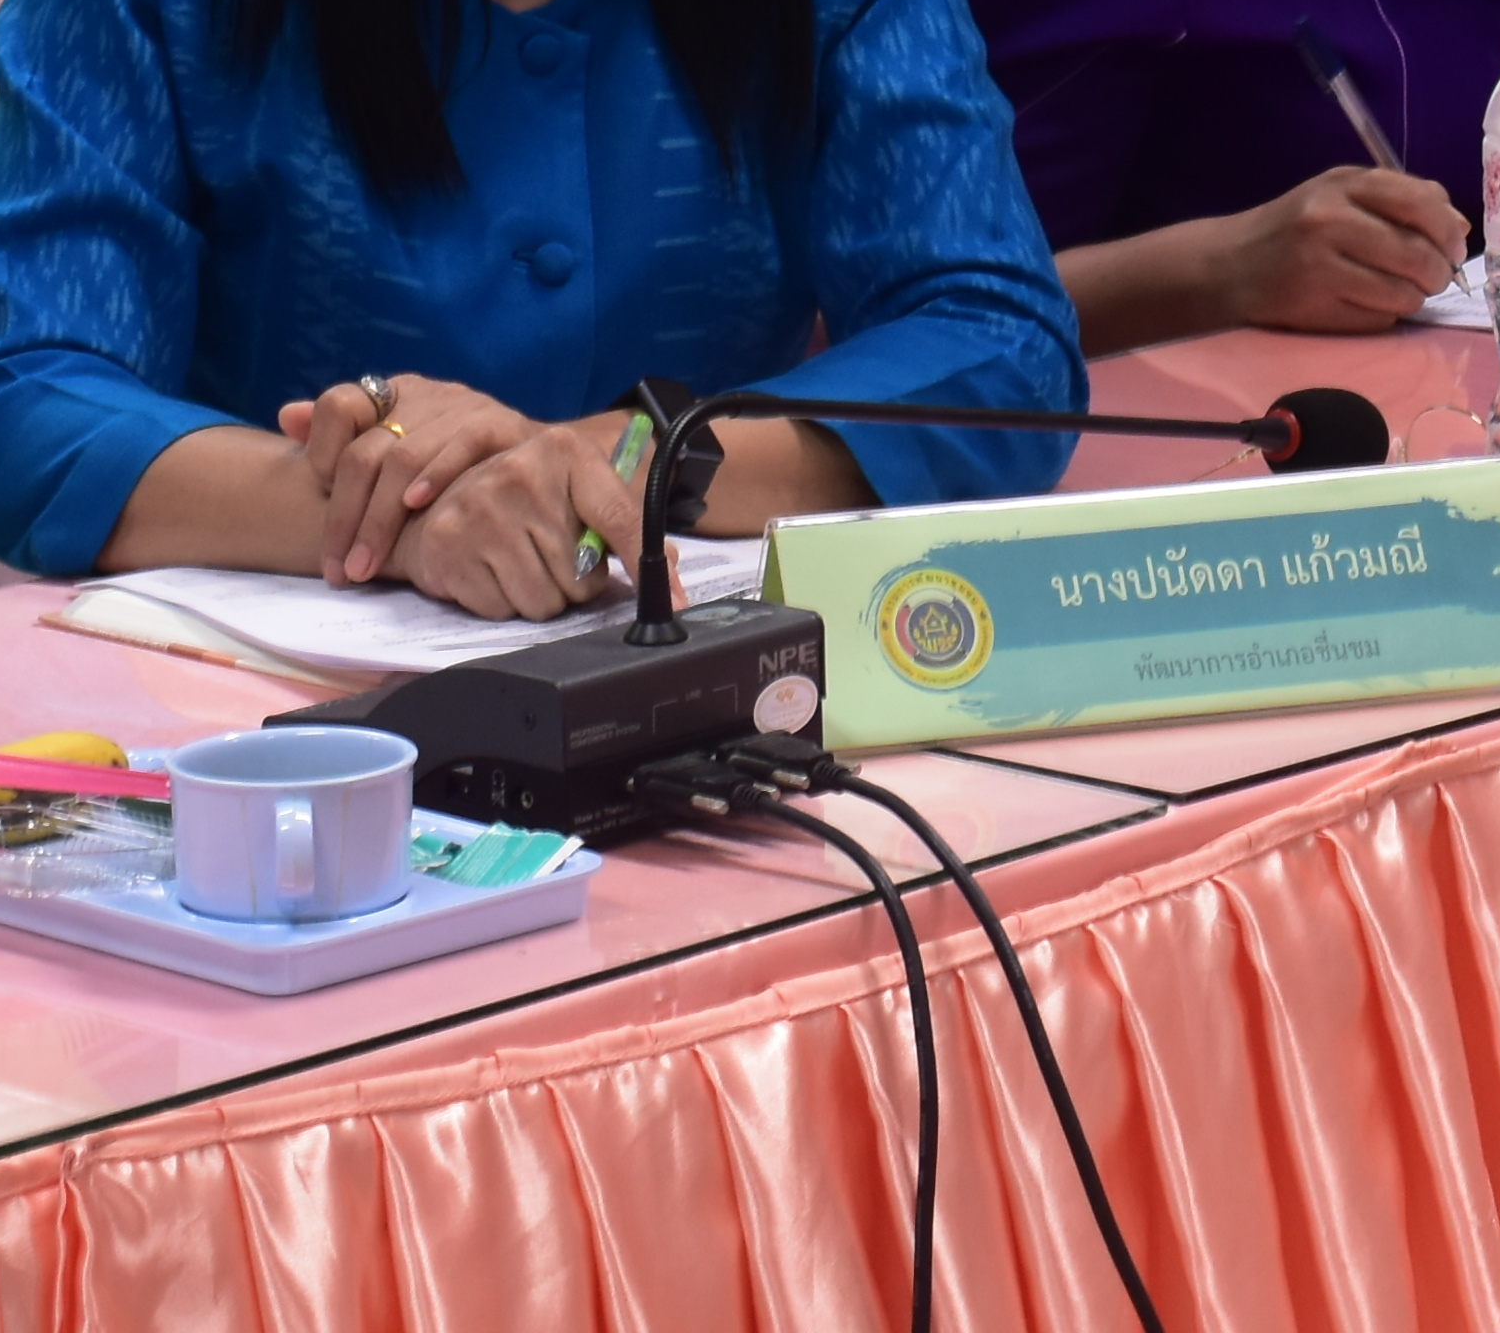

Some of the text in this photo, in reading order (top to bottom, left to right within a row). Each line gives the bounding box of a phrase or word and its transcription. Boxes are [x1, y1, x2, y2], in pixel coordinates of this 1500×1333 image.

[1051, 524, 1428, 608] นางปนัดดา แก้วมณี
[759, 641, 818, 674] NPE
[1133, 629, 1381, 682] พัฒนาการอำเภอชื่นชม
